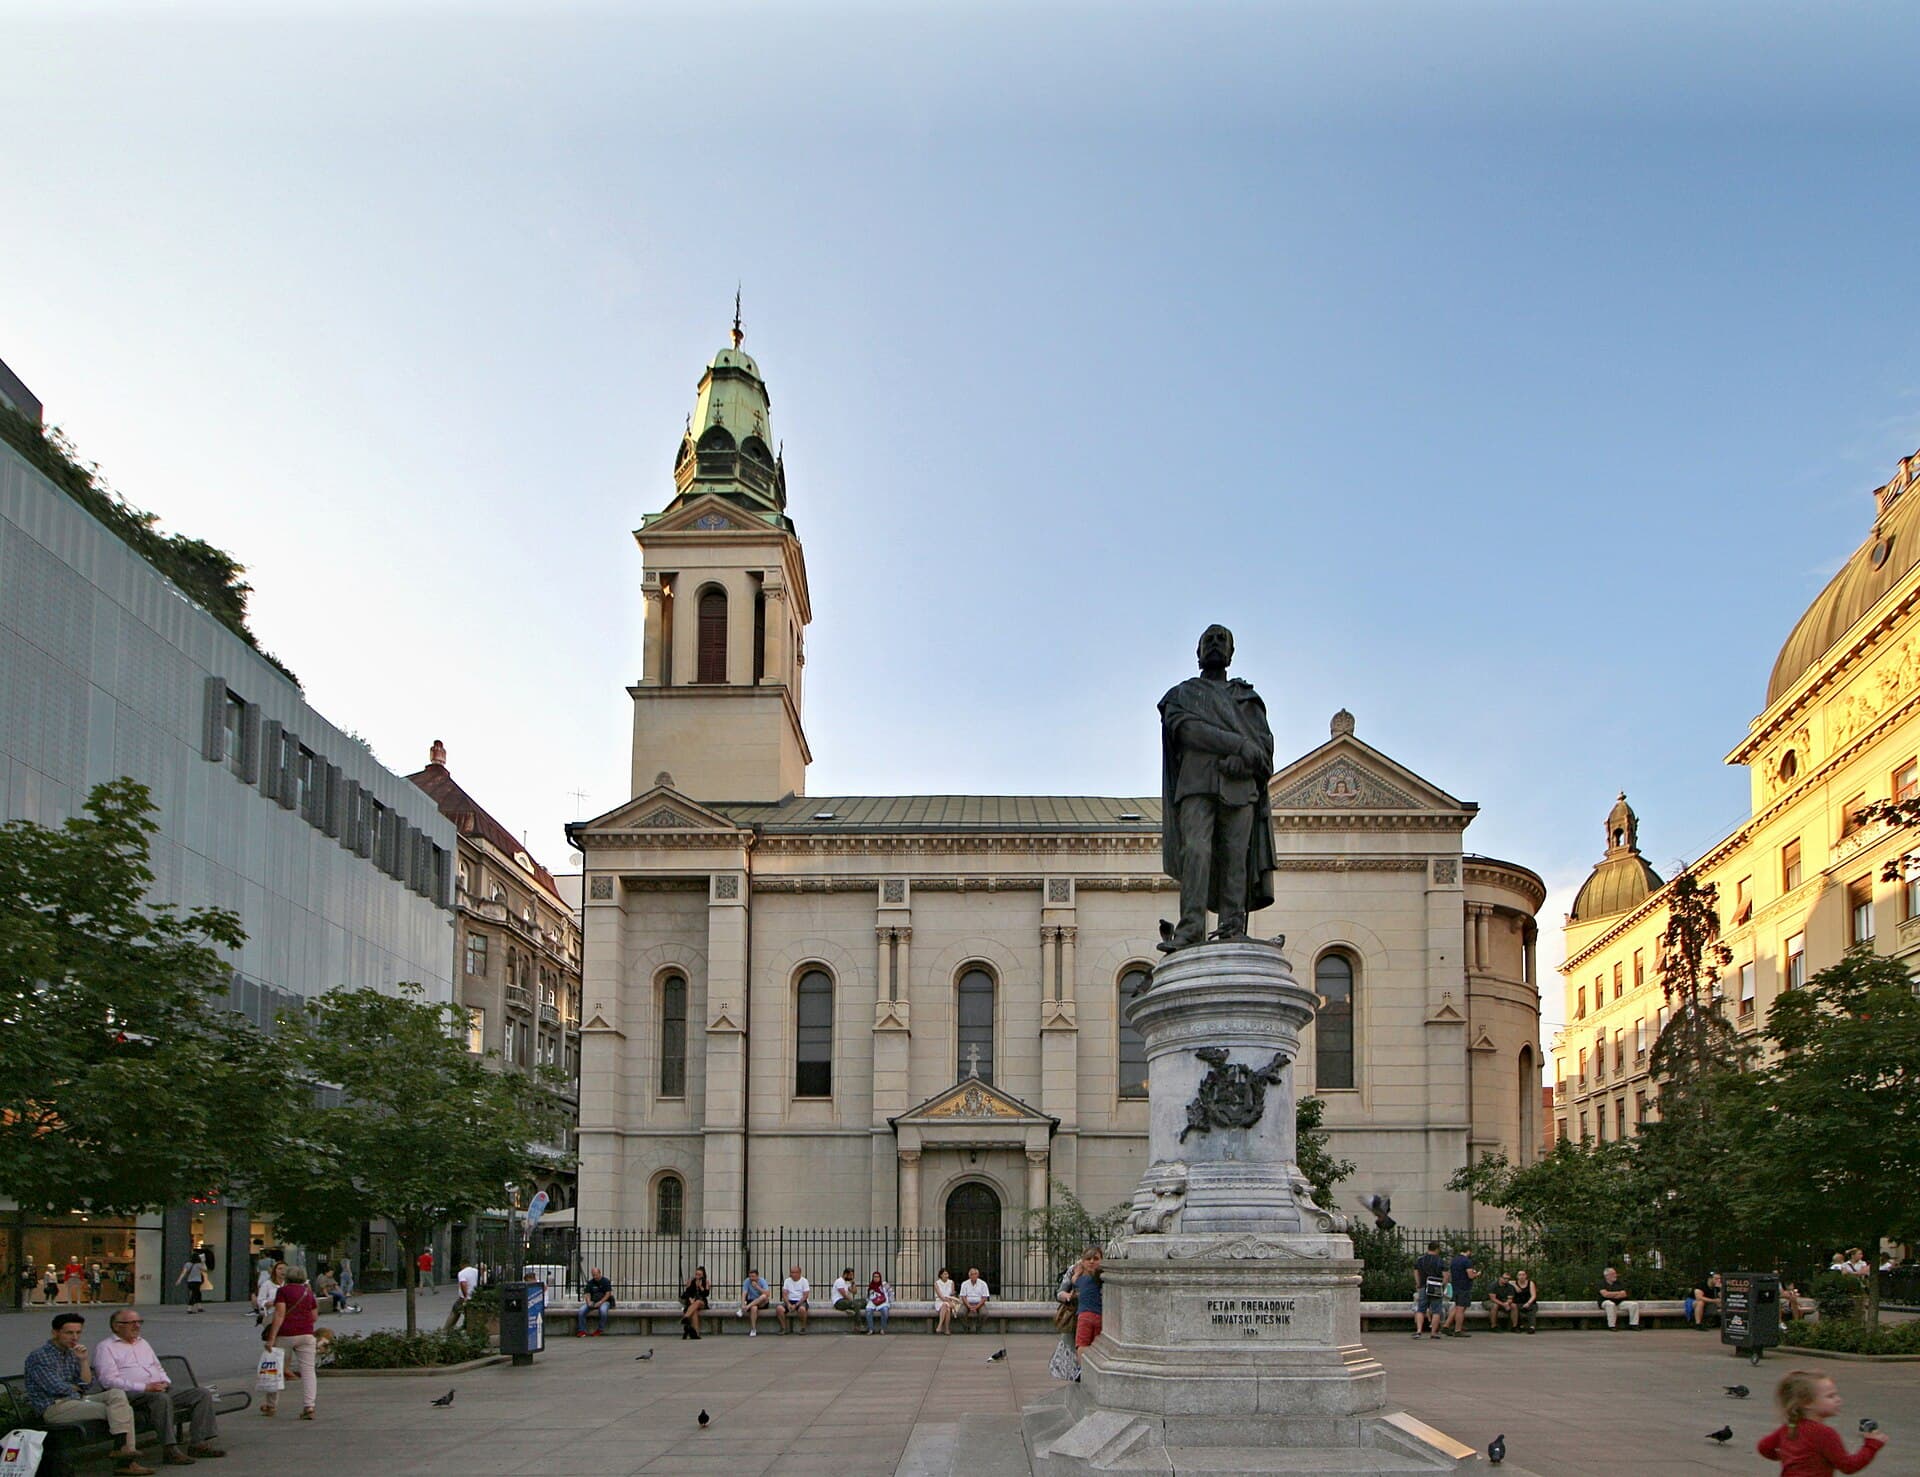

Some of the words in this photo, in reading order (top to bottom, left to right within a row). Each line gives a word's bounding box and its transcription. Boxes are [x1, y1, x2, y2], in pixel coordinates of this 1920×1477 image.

[1207, 1301, 1235, 1311] PETAR
[1241, 1298, 1295, 1311] PRERADOVIĆ
[1211, 1314, 1252, 1324] HRVATSKI
[1255, 1314, 1290, 1324] PIESNIK
